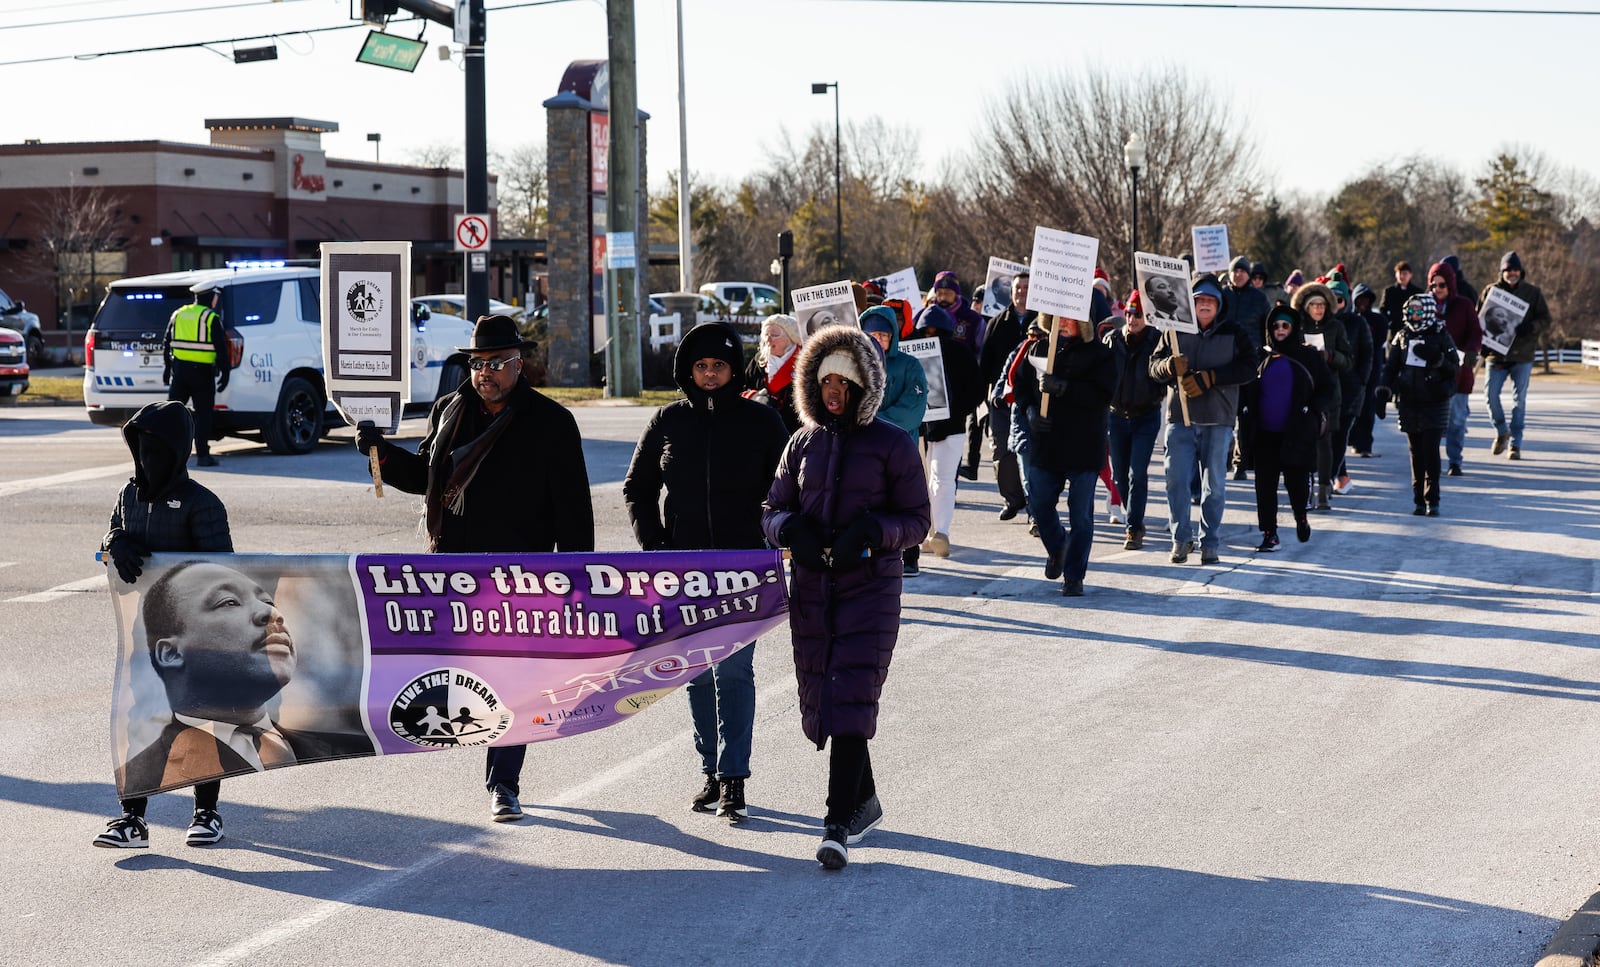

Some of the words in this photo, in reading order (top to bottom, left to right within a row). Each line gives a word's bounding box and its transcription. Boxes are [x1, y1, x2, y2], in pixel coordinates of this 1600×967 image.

[1038, 245, 1064, 256] between
[1064, 251, 1090, 260] violence
[992, 260, 1002, 268] LIVE
[1003, 262, 1012, 270] THE
[1050, 260, 1088, 273] nonviolence
[1138, 257, 1150, 266] LIVE
[1151, 259, 1162, 269] THE
[1162, 261, 1184, 272] DREAM
[1035, 268, 1042, 277] in
[1044, 270, 1059, 281] this
[796, 292, 811, 303] LIVE
[811, 290, 824, 300] THE
[824, 285, 849, 298] DREAM
[1044, 286, 1084, 300] nonviolence
[1502, 295, 1510, 303] THE
[1510, 299, 1526, 311] DREAM
[111, 341, 128, 350] West
[898, 344, 910, 353] THE
[912, 341, 936, 352] DREAM
[251, 353, 273, 368] Call
[341, 360, 352, 369] Martin
[352, 360, 365, 370] Luther
[382, 361, 390, 372] Day
[254, 370, 272, 383] 911
[368, 564, 477, 594] Live
[490, 564, 571, 595] the
[585, 564, 778, 598] Dream:
[385, 600, 435, 632] Our
[450, 601, 619, 636] Declaration
[636, 605, 664, 635] of
[679, 594, 760, 626] Unity
[396, 682, 423, 710] LIVE
[422, 673, 449, 689] THE
[455, 674, 498, 712] DREAM:
[548, 703, 606, 721] Liberty
[392, 721, 409, 736] OUR
[488, 731, 501, 739] OF
